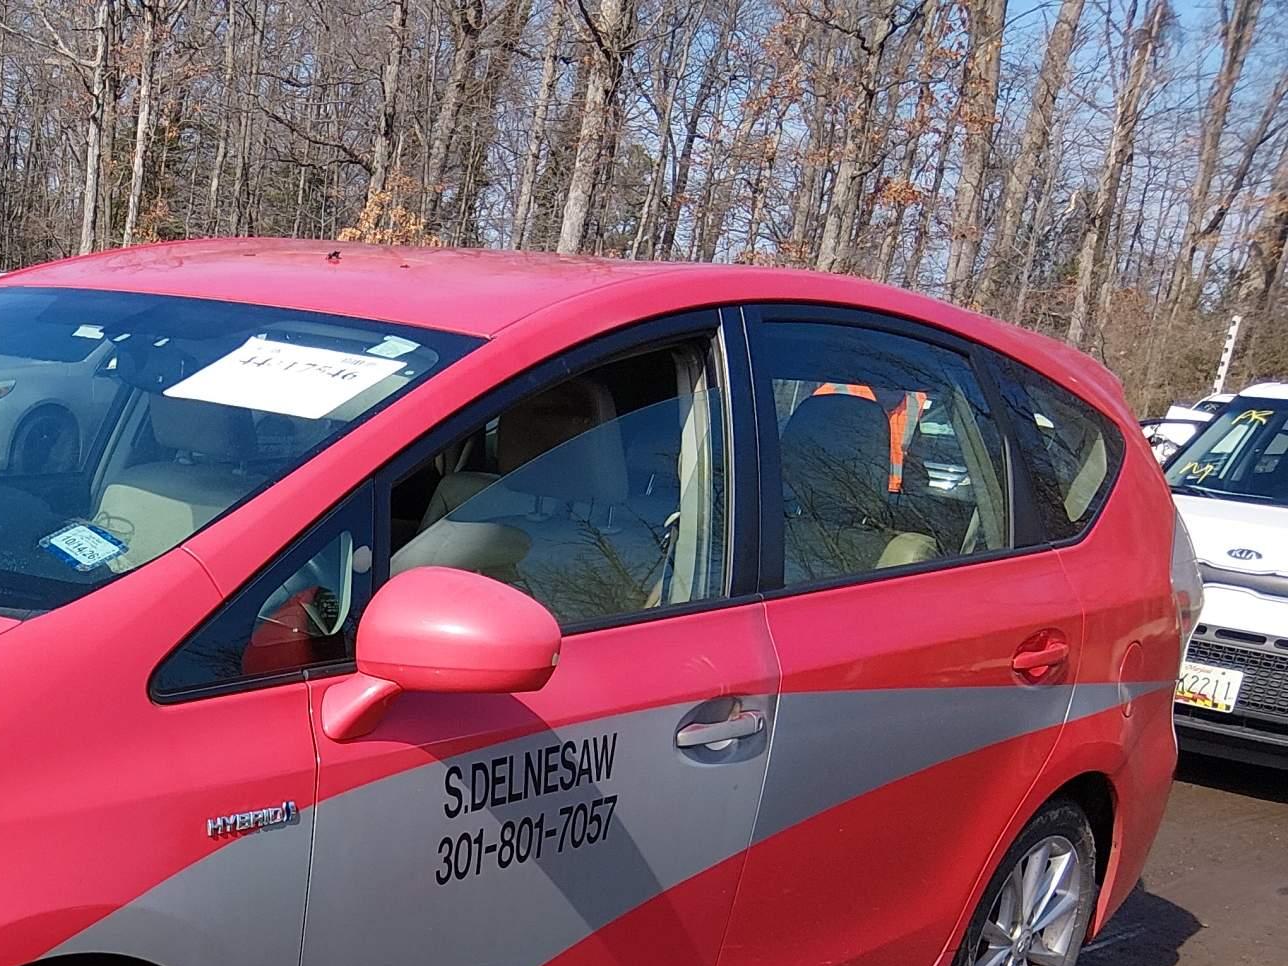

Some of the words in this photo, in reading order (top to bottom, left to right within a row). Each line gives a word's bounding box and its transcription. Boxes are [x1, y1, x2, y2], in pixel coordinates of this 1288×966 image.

[239, 355, 359, 381] 4417546
[444, 733, 618, 819] S.DELNESAW
[207, 807, 284, 837] HYBRID
[435, 795, 618, 885] 301-801-7057
